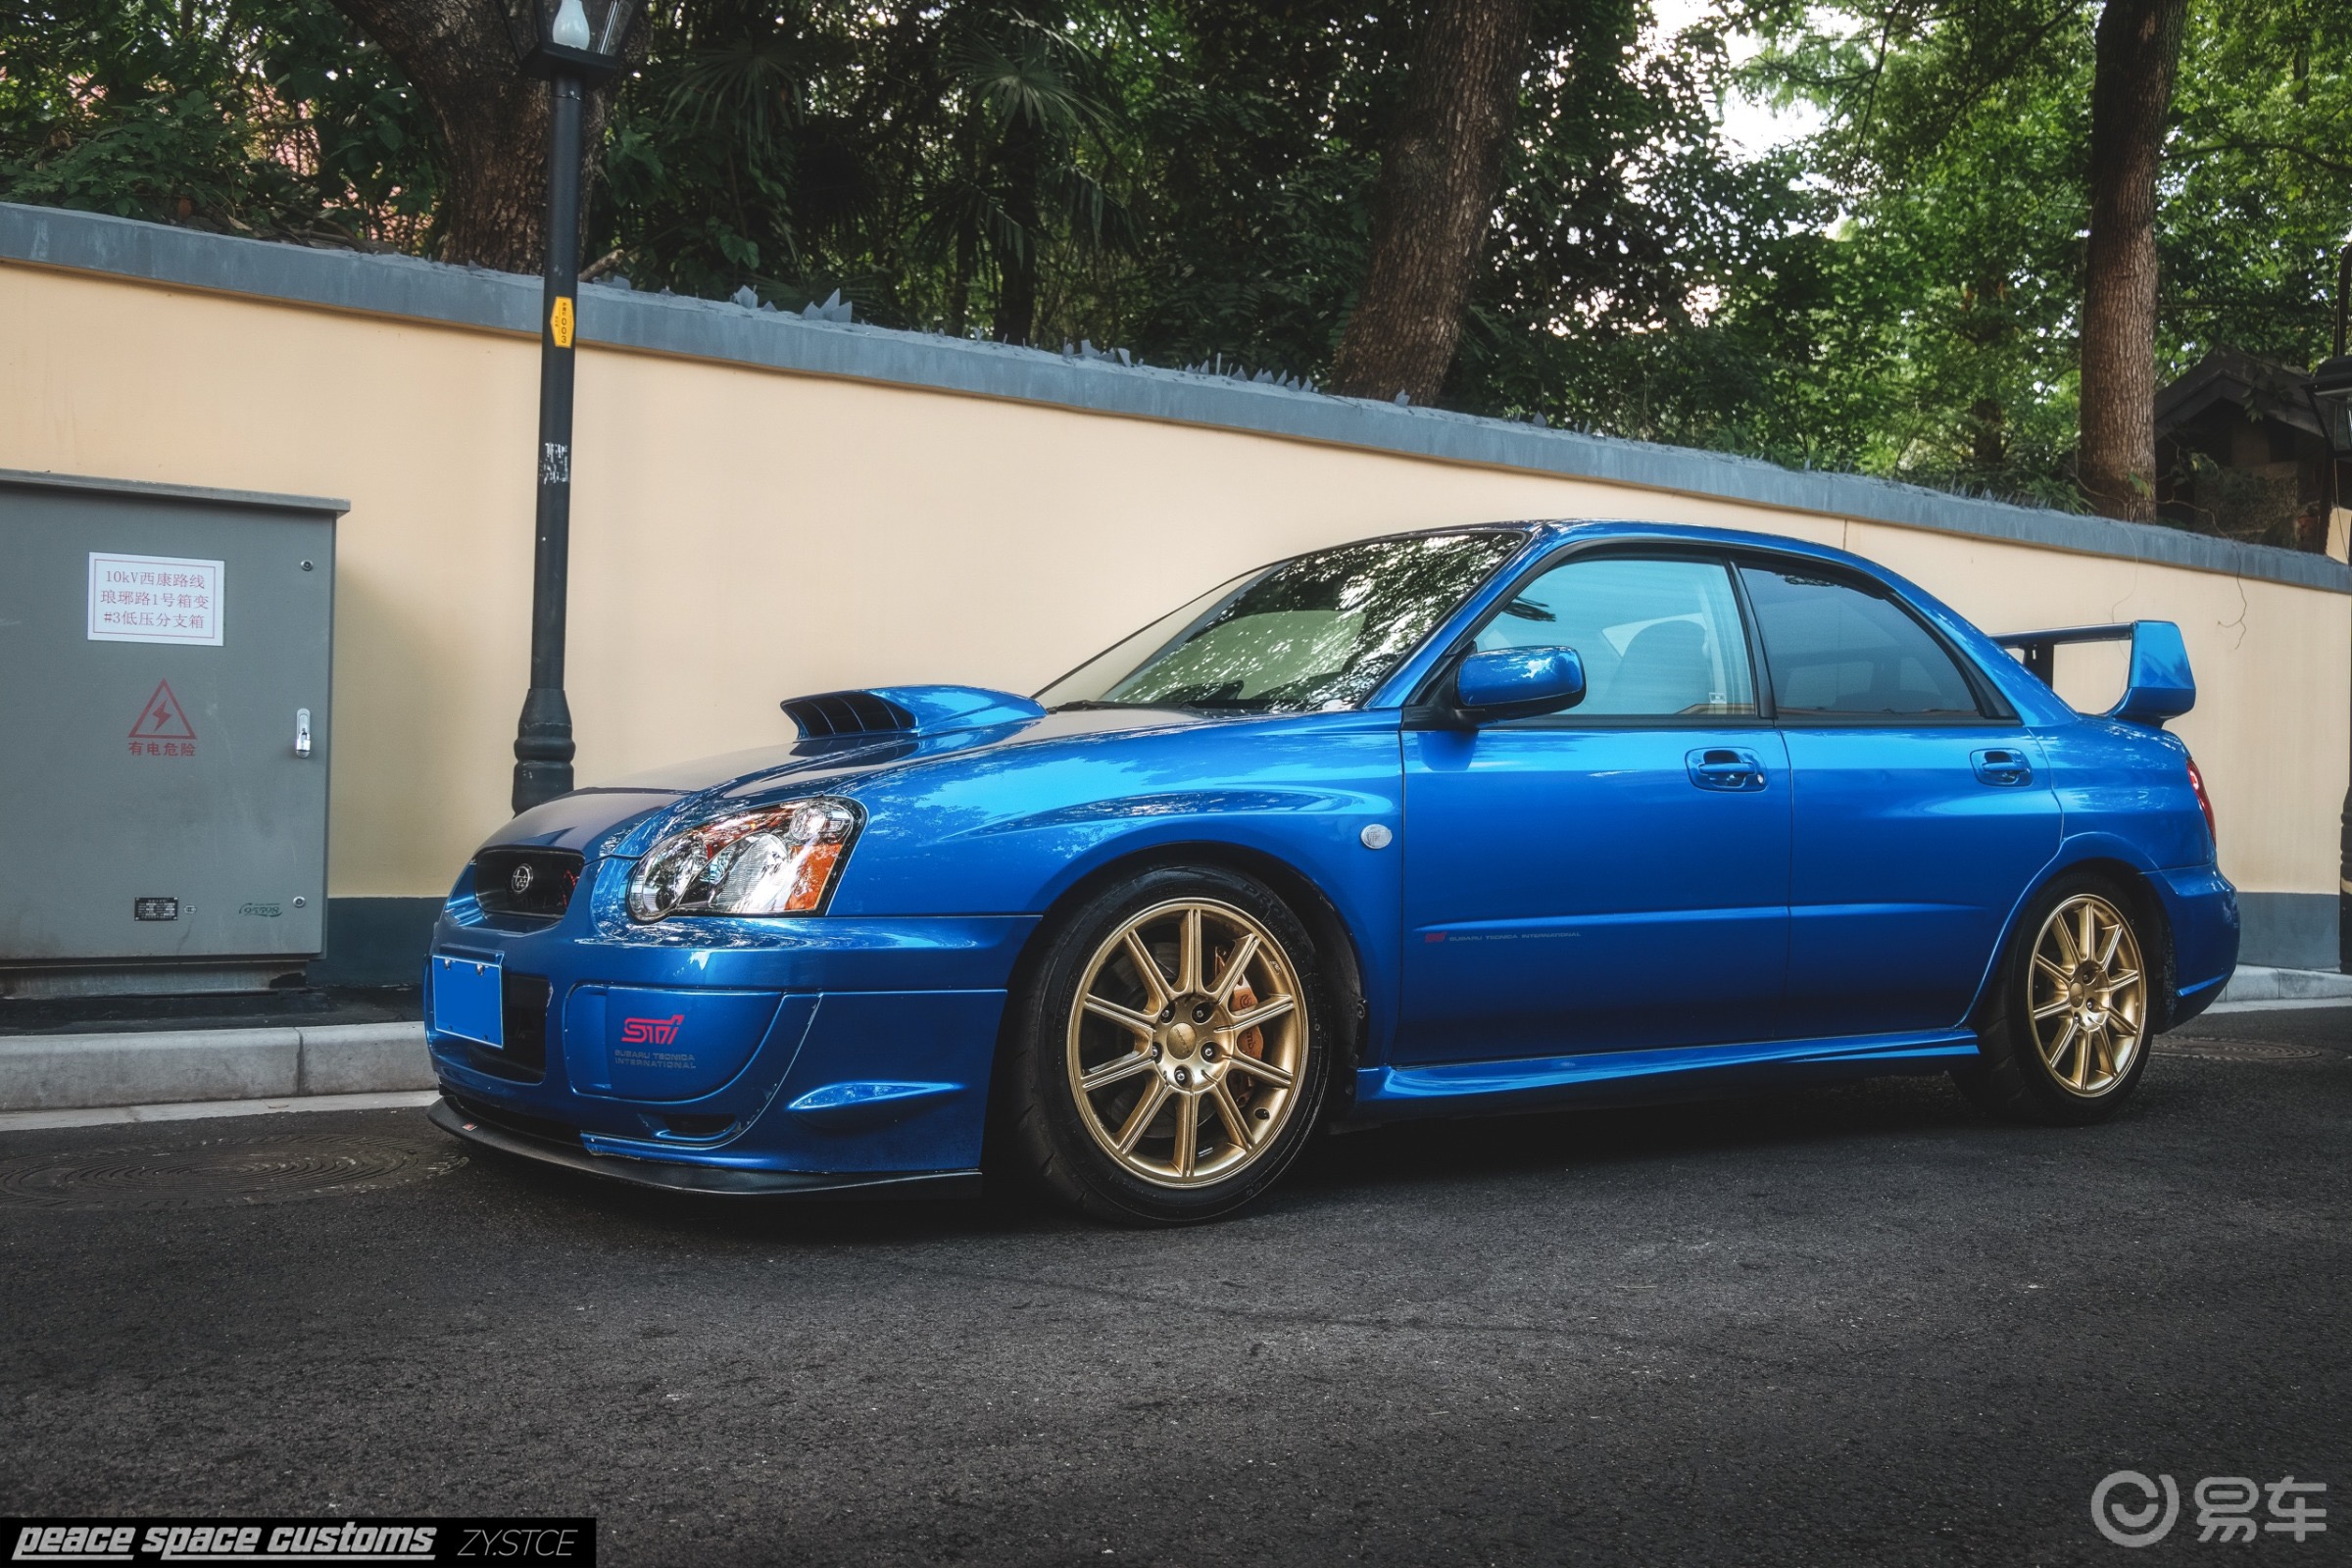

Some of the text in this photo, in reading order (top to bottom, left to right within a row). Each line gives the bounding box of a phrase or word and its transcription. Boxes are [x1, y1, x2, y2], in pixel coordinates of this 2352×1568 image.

[106, 570, 205, 589] 10kV西康路线
[100, 590, 209, 610] 琅琊路1号箱变
[104, 611, 204, 629] #3低压分支箱
[127, 741, 196, 757] 有电危险
[614, 1049, 651, 1059] SUBARU
[614, 1057, 697, 1069] INTERNATIONAL
